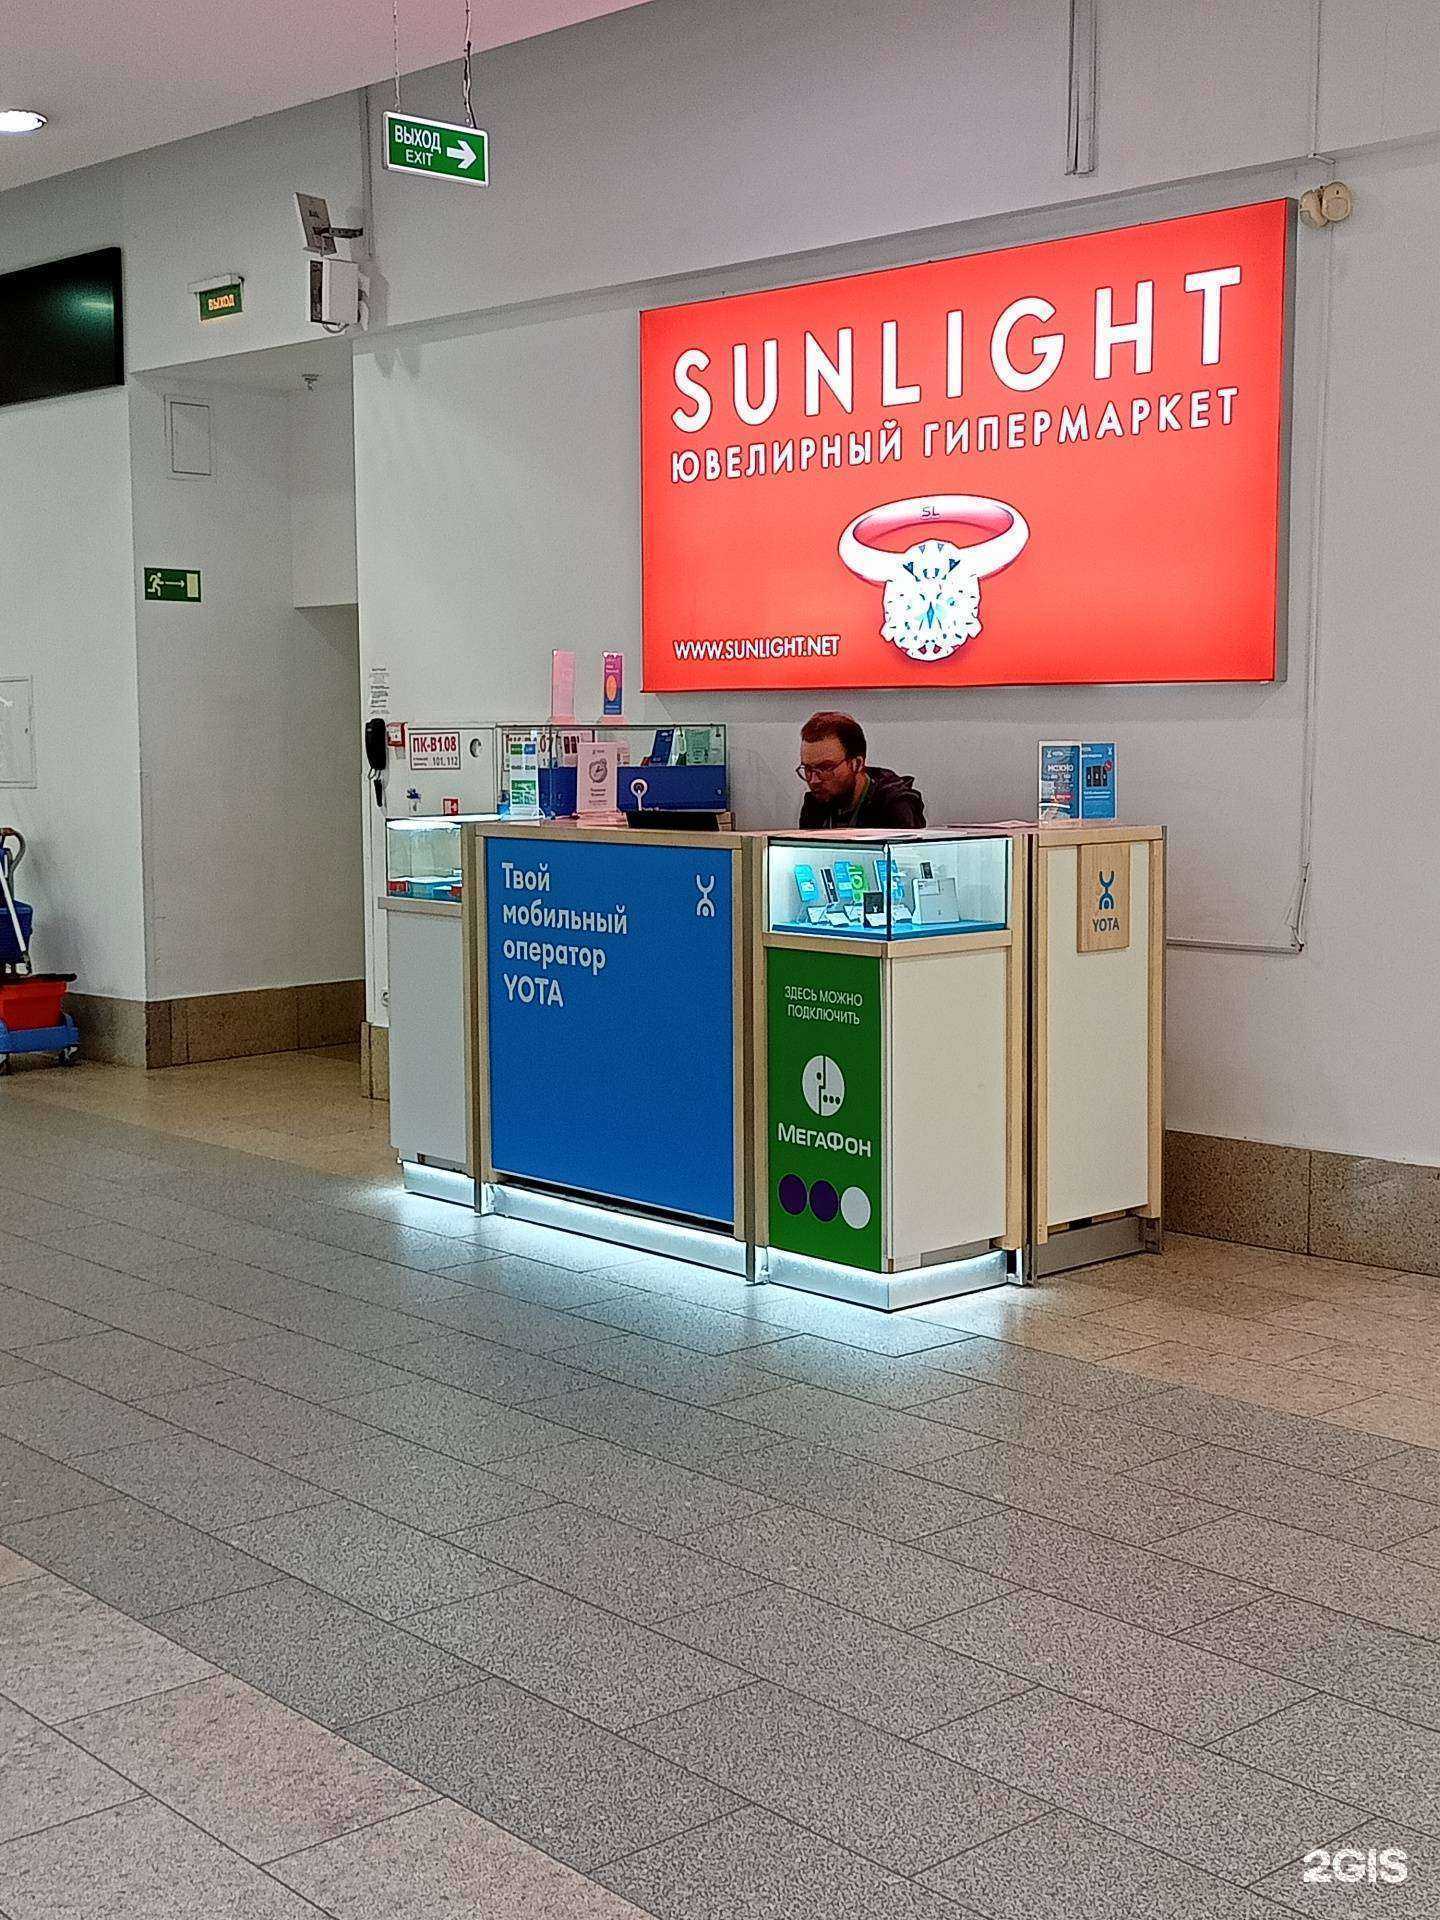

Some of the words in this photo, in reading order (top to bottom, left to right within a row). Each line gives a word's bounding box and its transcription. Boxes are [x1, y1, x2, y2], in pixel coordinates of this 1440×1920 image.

[394, 124, 442, 154] ВЫХОД
[405, 148, 433, 166] EXIT
[208, 294, 235, 311] ВЫХОД
[671, 265, 1242, 434] SUNLIGHT
[671, 418, 902, 484] ЮВЕЛИРНЫЙ
[923, 386, 1239, 458] ГИПЕРМАРКЕТ
[673, 635, 841, 660] WWW.SUNLIGHT.NET
[501, 861, 550, 892] Твой
[502, 898, 628, 935] мобильный
[1092, 917, 1120, 933] YOTA
[503, 938, 606, 976] оператор
[503, 972, 564, 1008] YOTA
[784, 985, 818, 1002] ЗДЕСЬ
[819, 990, 863, 1007] МОЖНО
[787, 1003, 861, 1025] ПОДКЛЮЧИТЬ
